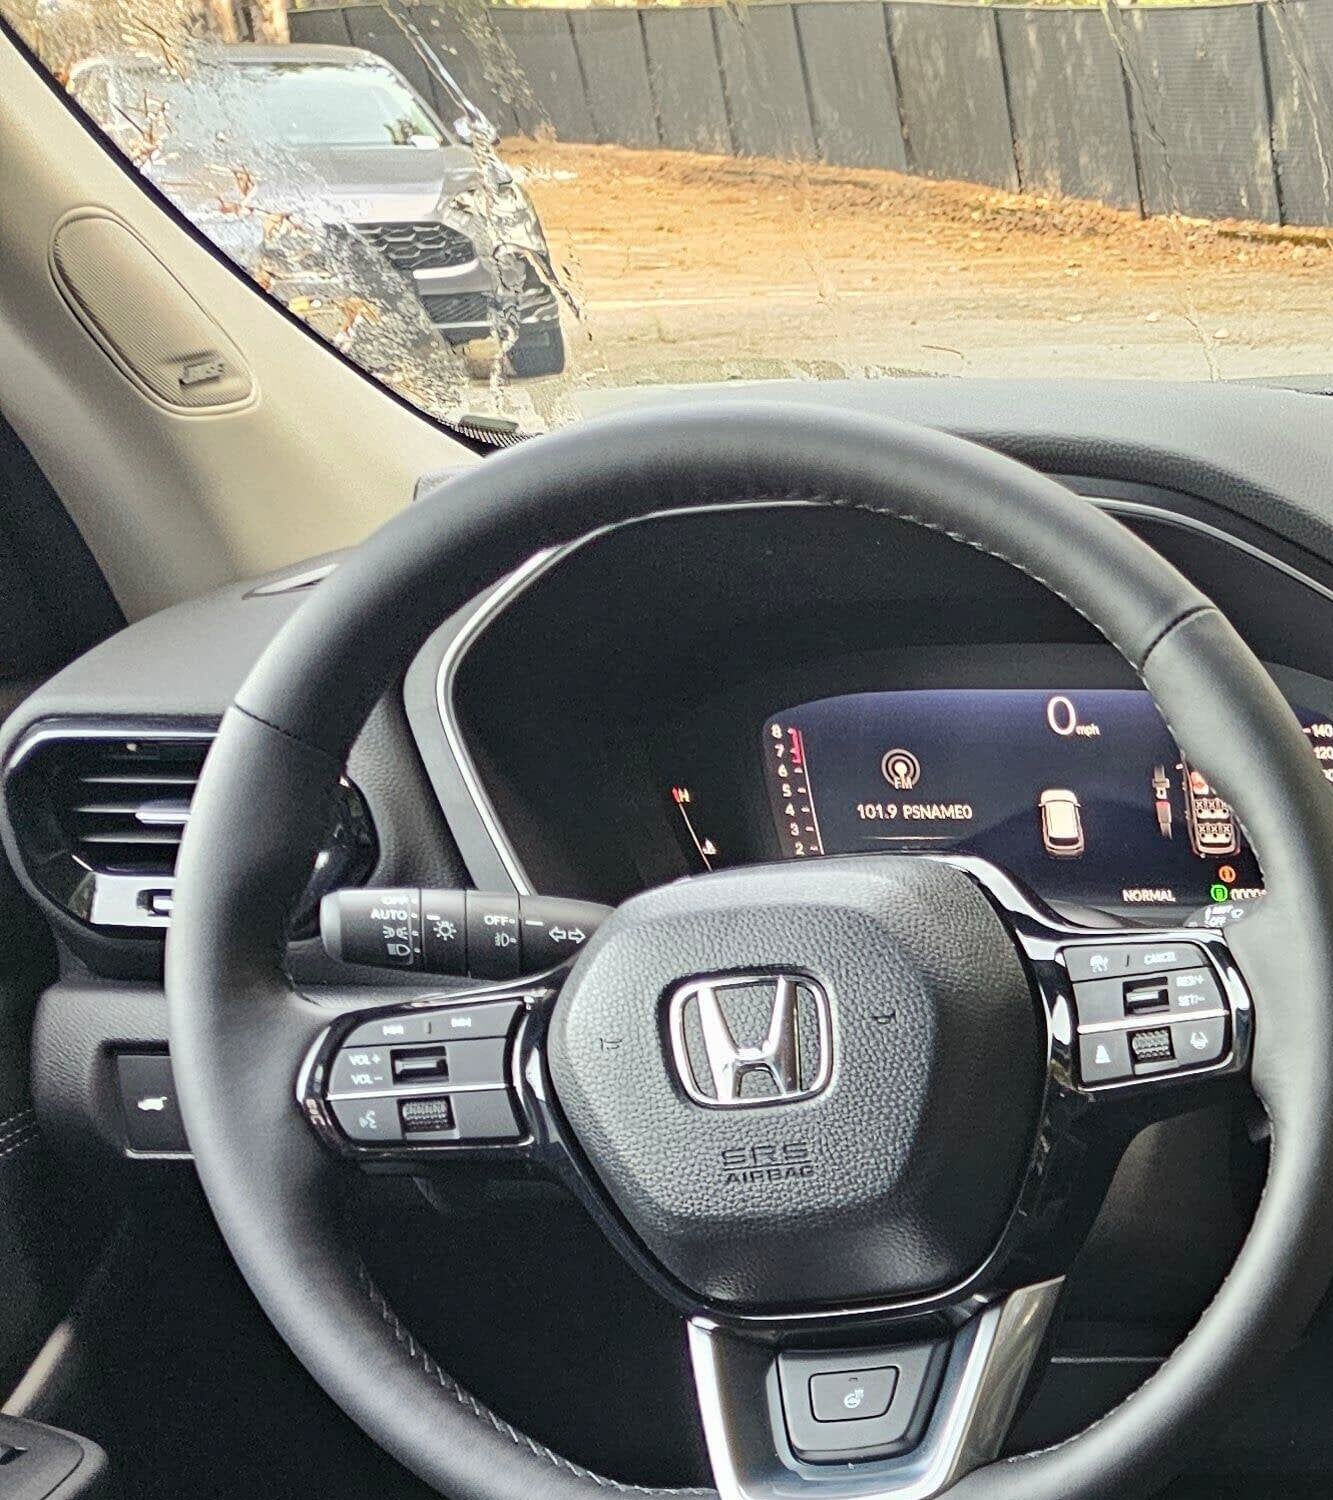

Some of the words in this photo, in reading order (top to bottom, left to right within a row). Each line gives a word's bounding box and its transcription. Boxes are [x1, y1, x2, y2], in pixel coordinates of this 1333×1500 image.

[1046, 695, 1077, 736] 0
[1075, 722, 1101, 738] mph
[771, 723, 783, 739] 8
[1310, 723, 1333, 738] 140
[774, 743, 785, 758] 7
[777, 763, 788, 778] 6
[782, 783, 792, 798] 5
[894, 777, 913, 790] FM
[784, 802, 796, 817] 4
[857, 804, 898, 820] 101.9
[903, 804, 973, 820] PSNAME0
[790, 822, 800, 836] 3
[795, 842, 805, 856] 2
[1122, 889, 1176, 902] NORMAL
[370, 908, 408, 920] AUTO
[484, 915, 508, 926] OFF
[349, 1055, 371, 1066] VOL
[351, 1074, 374, 1086] VOL
[721, 1140, 810, 1167] SRS
[726, 1164, 816, 1184] AIRBAG
